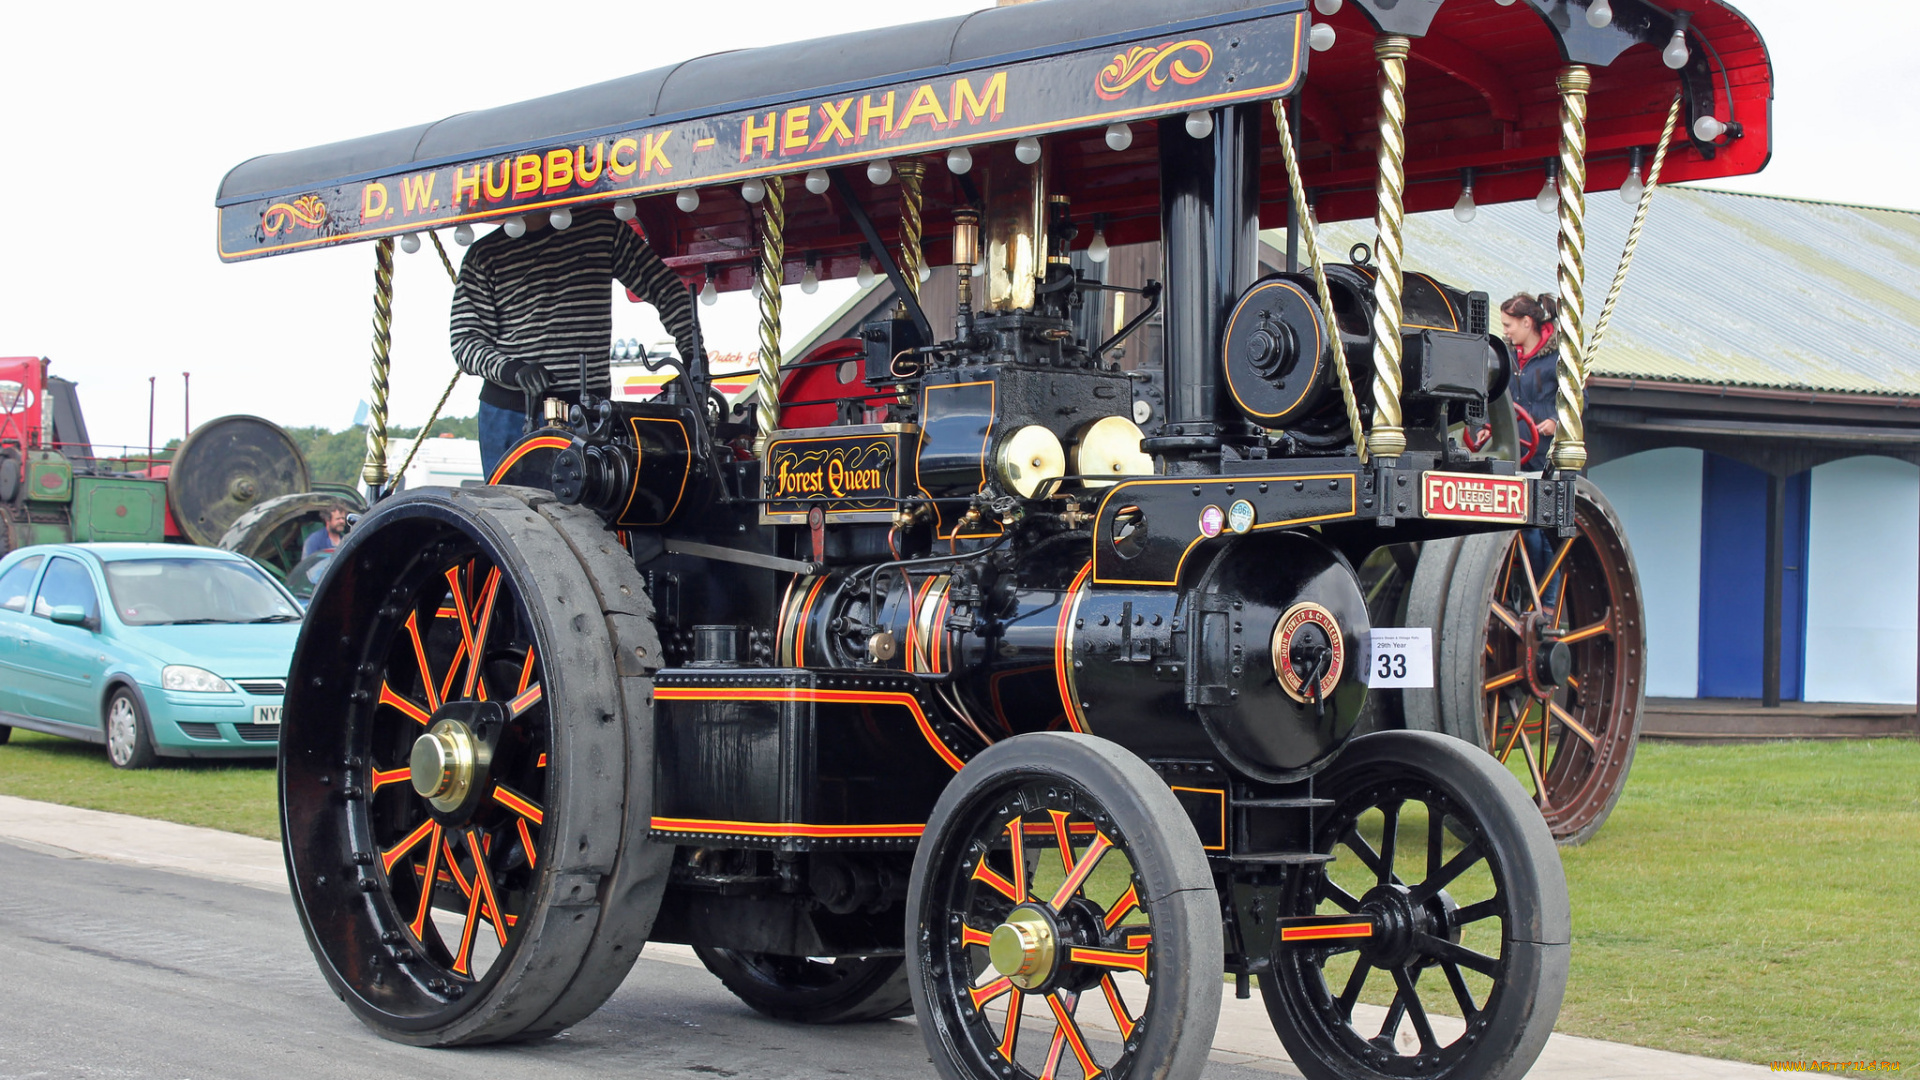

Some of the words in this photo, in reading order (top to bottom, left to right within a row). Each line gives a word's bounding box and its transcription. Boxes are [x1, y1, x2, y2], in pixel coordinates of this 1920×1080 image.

[361, 182, 394, 223] D.
[401, 172, 440, 215] W.
[453, 130, 674, 208] HUBBUCK
[742, 71, 1008, 162] HEXHAM
[708, 350, 743, 364] Dutch
[775, 459, 825, 497] Forest
[828, 458, 881, 498] Queen
[1429, 480, 1523, 514] FOWLER
[1460, 491, 1491, 503] LEEDS
[1281, 638, 1289, 659] JOHN
[1285, 612, 1306, 635] FOWLER
[1377, 654, 1407, 679] 33
[260, 707, 283, 721] NY
